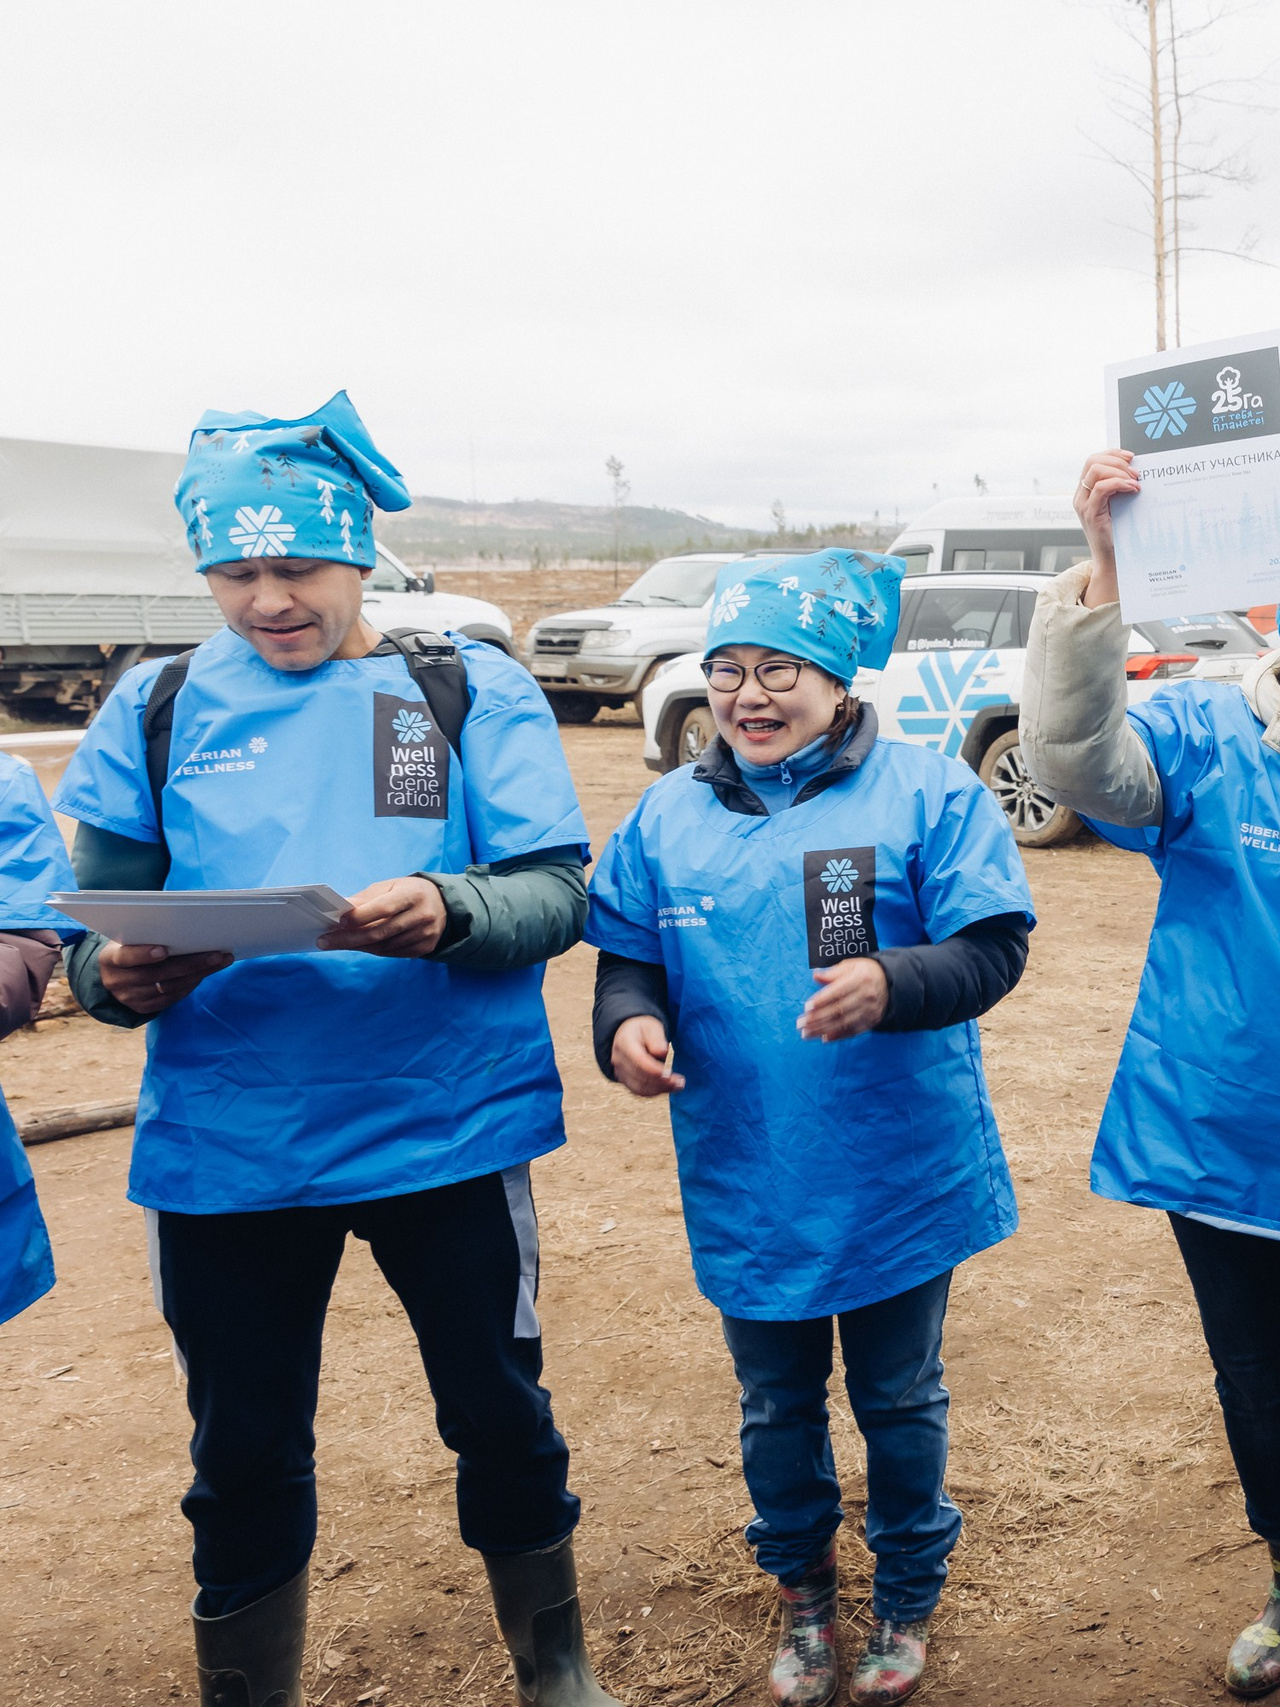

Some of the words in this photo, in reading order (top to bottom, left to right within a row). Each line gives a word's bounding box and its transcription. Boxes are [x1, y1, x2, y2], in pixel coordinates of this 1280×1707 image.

[1211, 387, 1263, 414] 25га
[1212, 415, 1226, 424] от
[1229, 410, 1253, 420] тебя
[1213, 417, 1264, 432] планете!
[1137, 461, 1206, 482] ЕРТИФИКАТ
[391, 746, 435, 763] Well
[391, 763, 436, 777] ness
[389, 774, 439, 792] Gene
[387, 790, 440, 807] ration
[821, 897, 861, 914] Well
[822, 914, 862, 928] ness
[820, 927, 866, 943] Gene
[819, 940, 869, 957] ration
